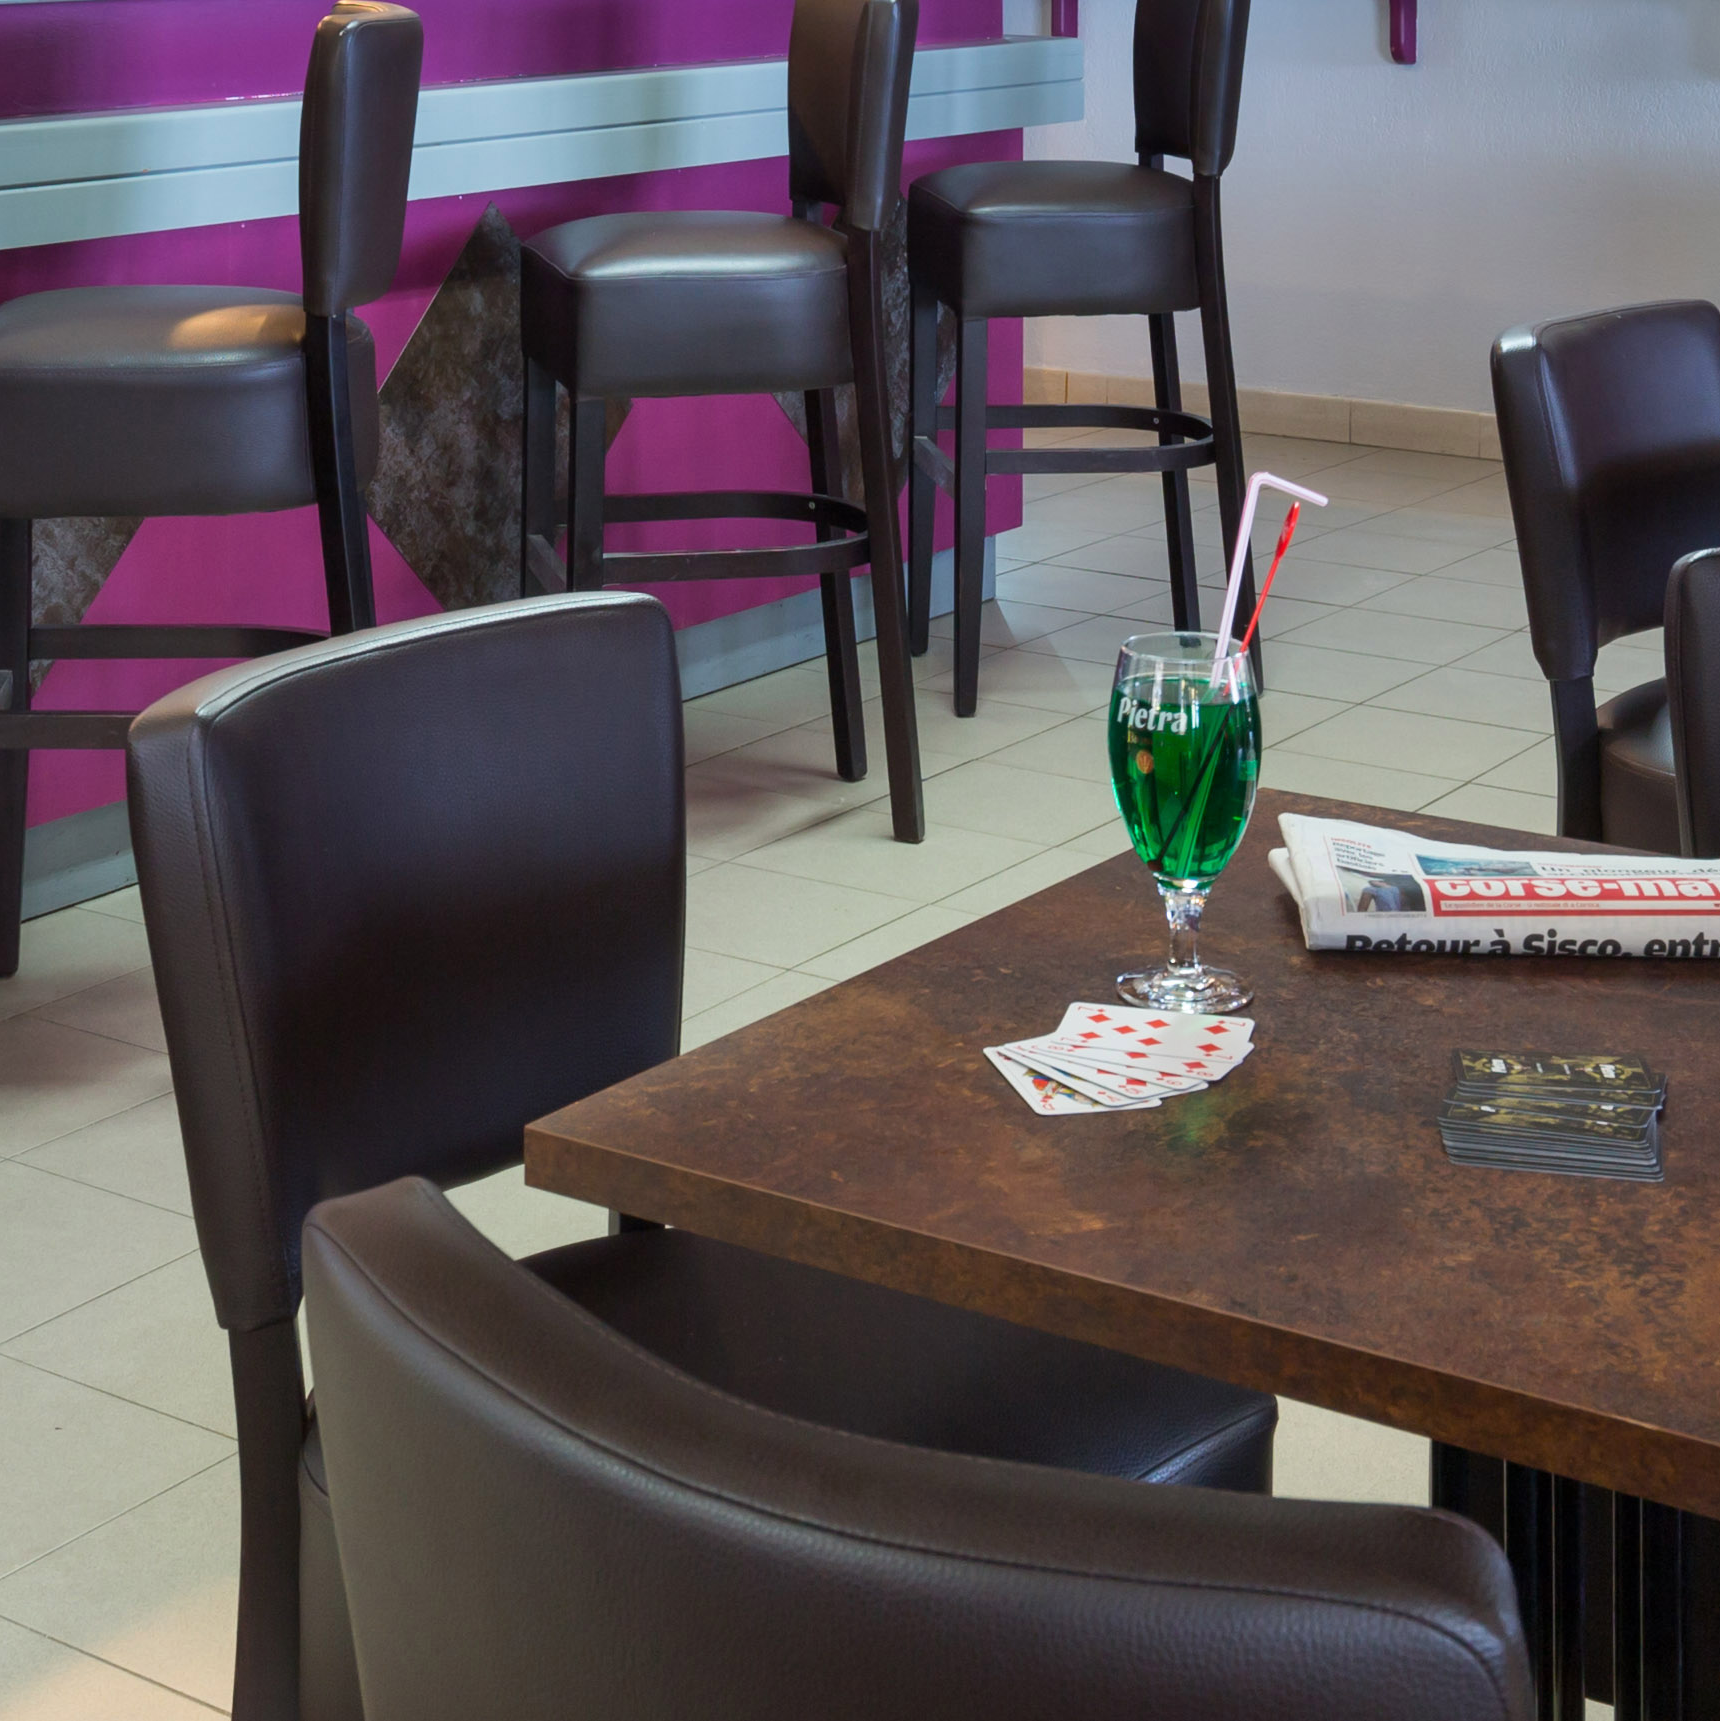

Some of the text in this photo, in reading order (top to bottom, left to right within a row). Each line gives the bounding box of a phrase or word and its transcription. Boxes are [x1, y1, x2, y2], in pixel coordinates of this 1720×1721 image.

[1117, 696, 1188, 736] Pietra
[1490, 928, 1512, 956] à
[1522, 928, 1633, 957] Sisco,
